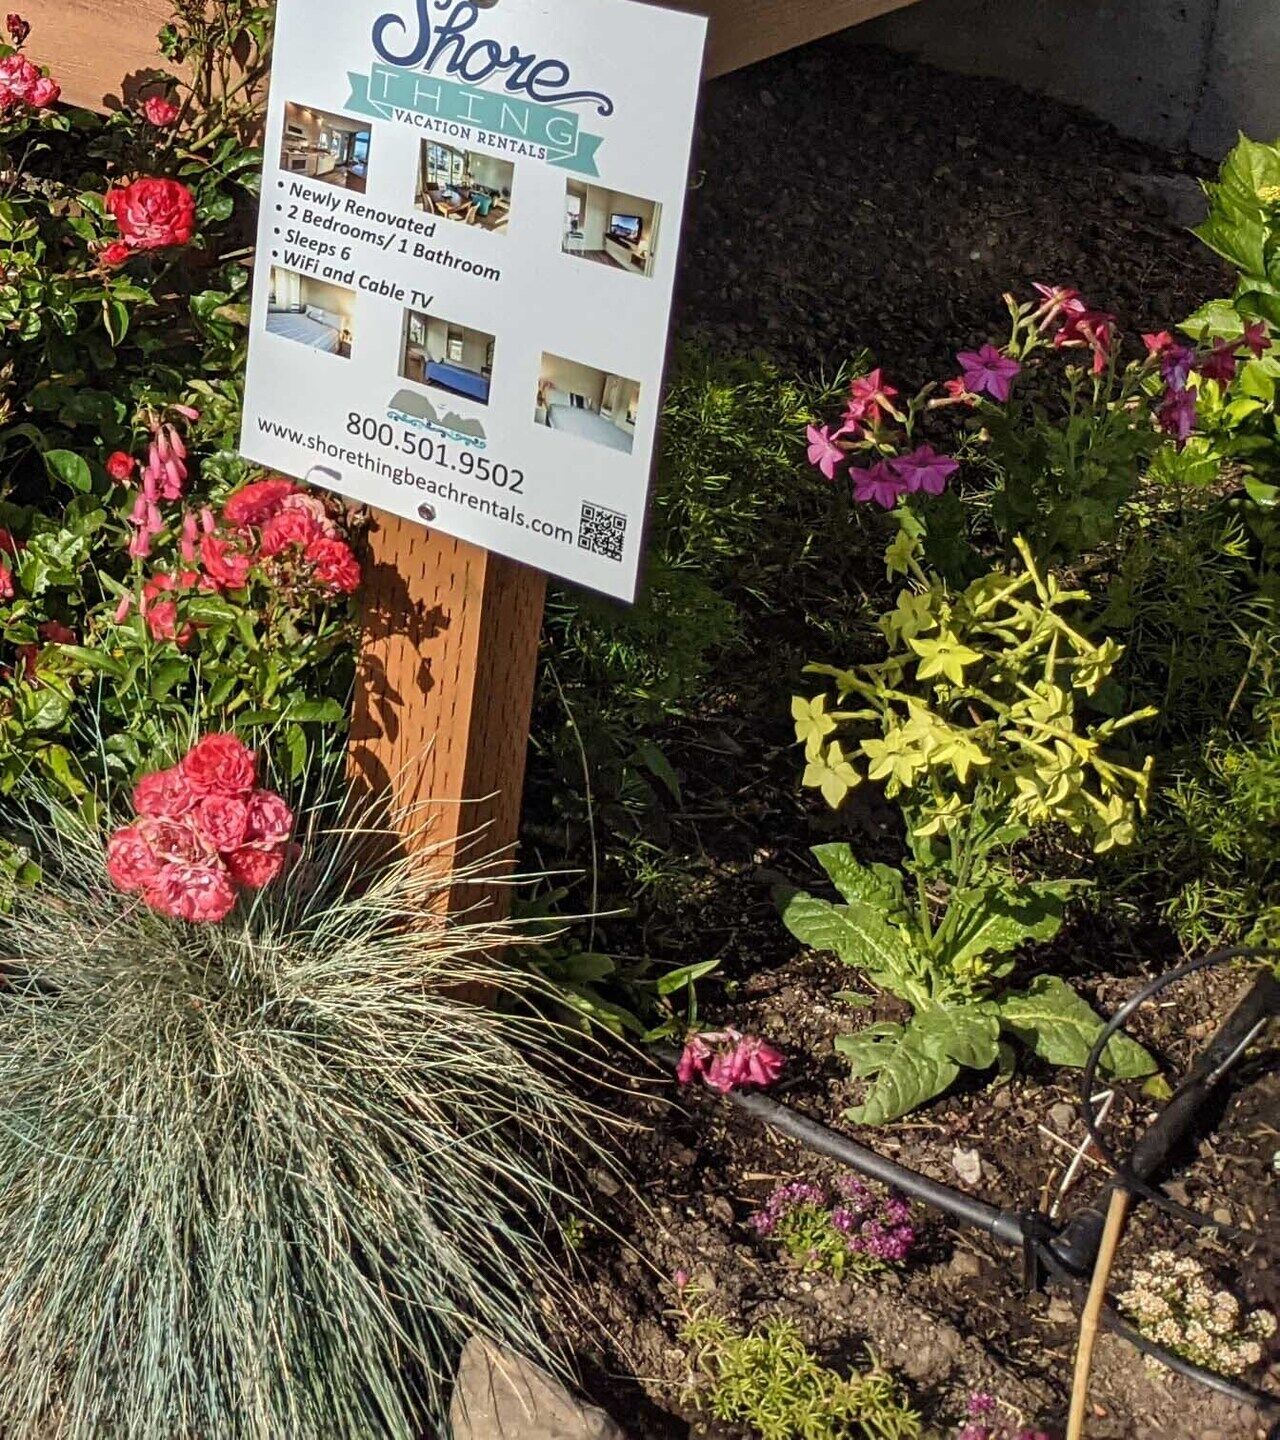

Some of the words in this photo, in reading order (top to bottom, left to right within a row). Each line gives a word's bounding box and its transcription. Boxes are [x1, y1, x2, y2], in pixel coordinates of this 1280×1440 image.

[374, 70, 572, 146] THING
[394, 109, 471, 141] VACATION
[477, 131, 547, 161] RENTALS
[287, 205, 299, 220] 2
[302, 209, 396, 250] Bedrooms/
[397, 239, 408, 254] 1
[413, 243, 502, 282] Bathroom
[289, 182, 342, 210] Newly
[345, 198, 437, 238] Renovated
[284, 228, 336, 257] Sleeps
[340, 247, 352, 261] 6
[284, 249, 321, 274] WiFi
[322, 265, 356, 285] and
[358, 274, 406, 301] Cable
[410, 290, 434, 309] TV
[257, 416, 573, 545] www.shorethingbeachrentals.com
[346, 411, 525, 495] 800.501.9502
